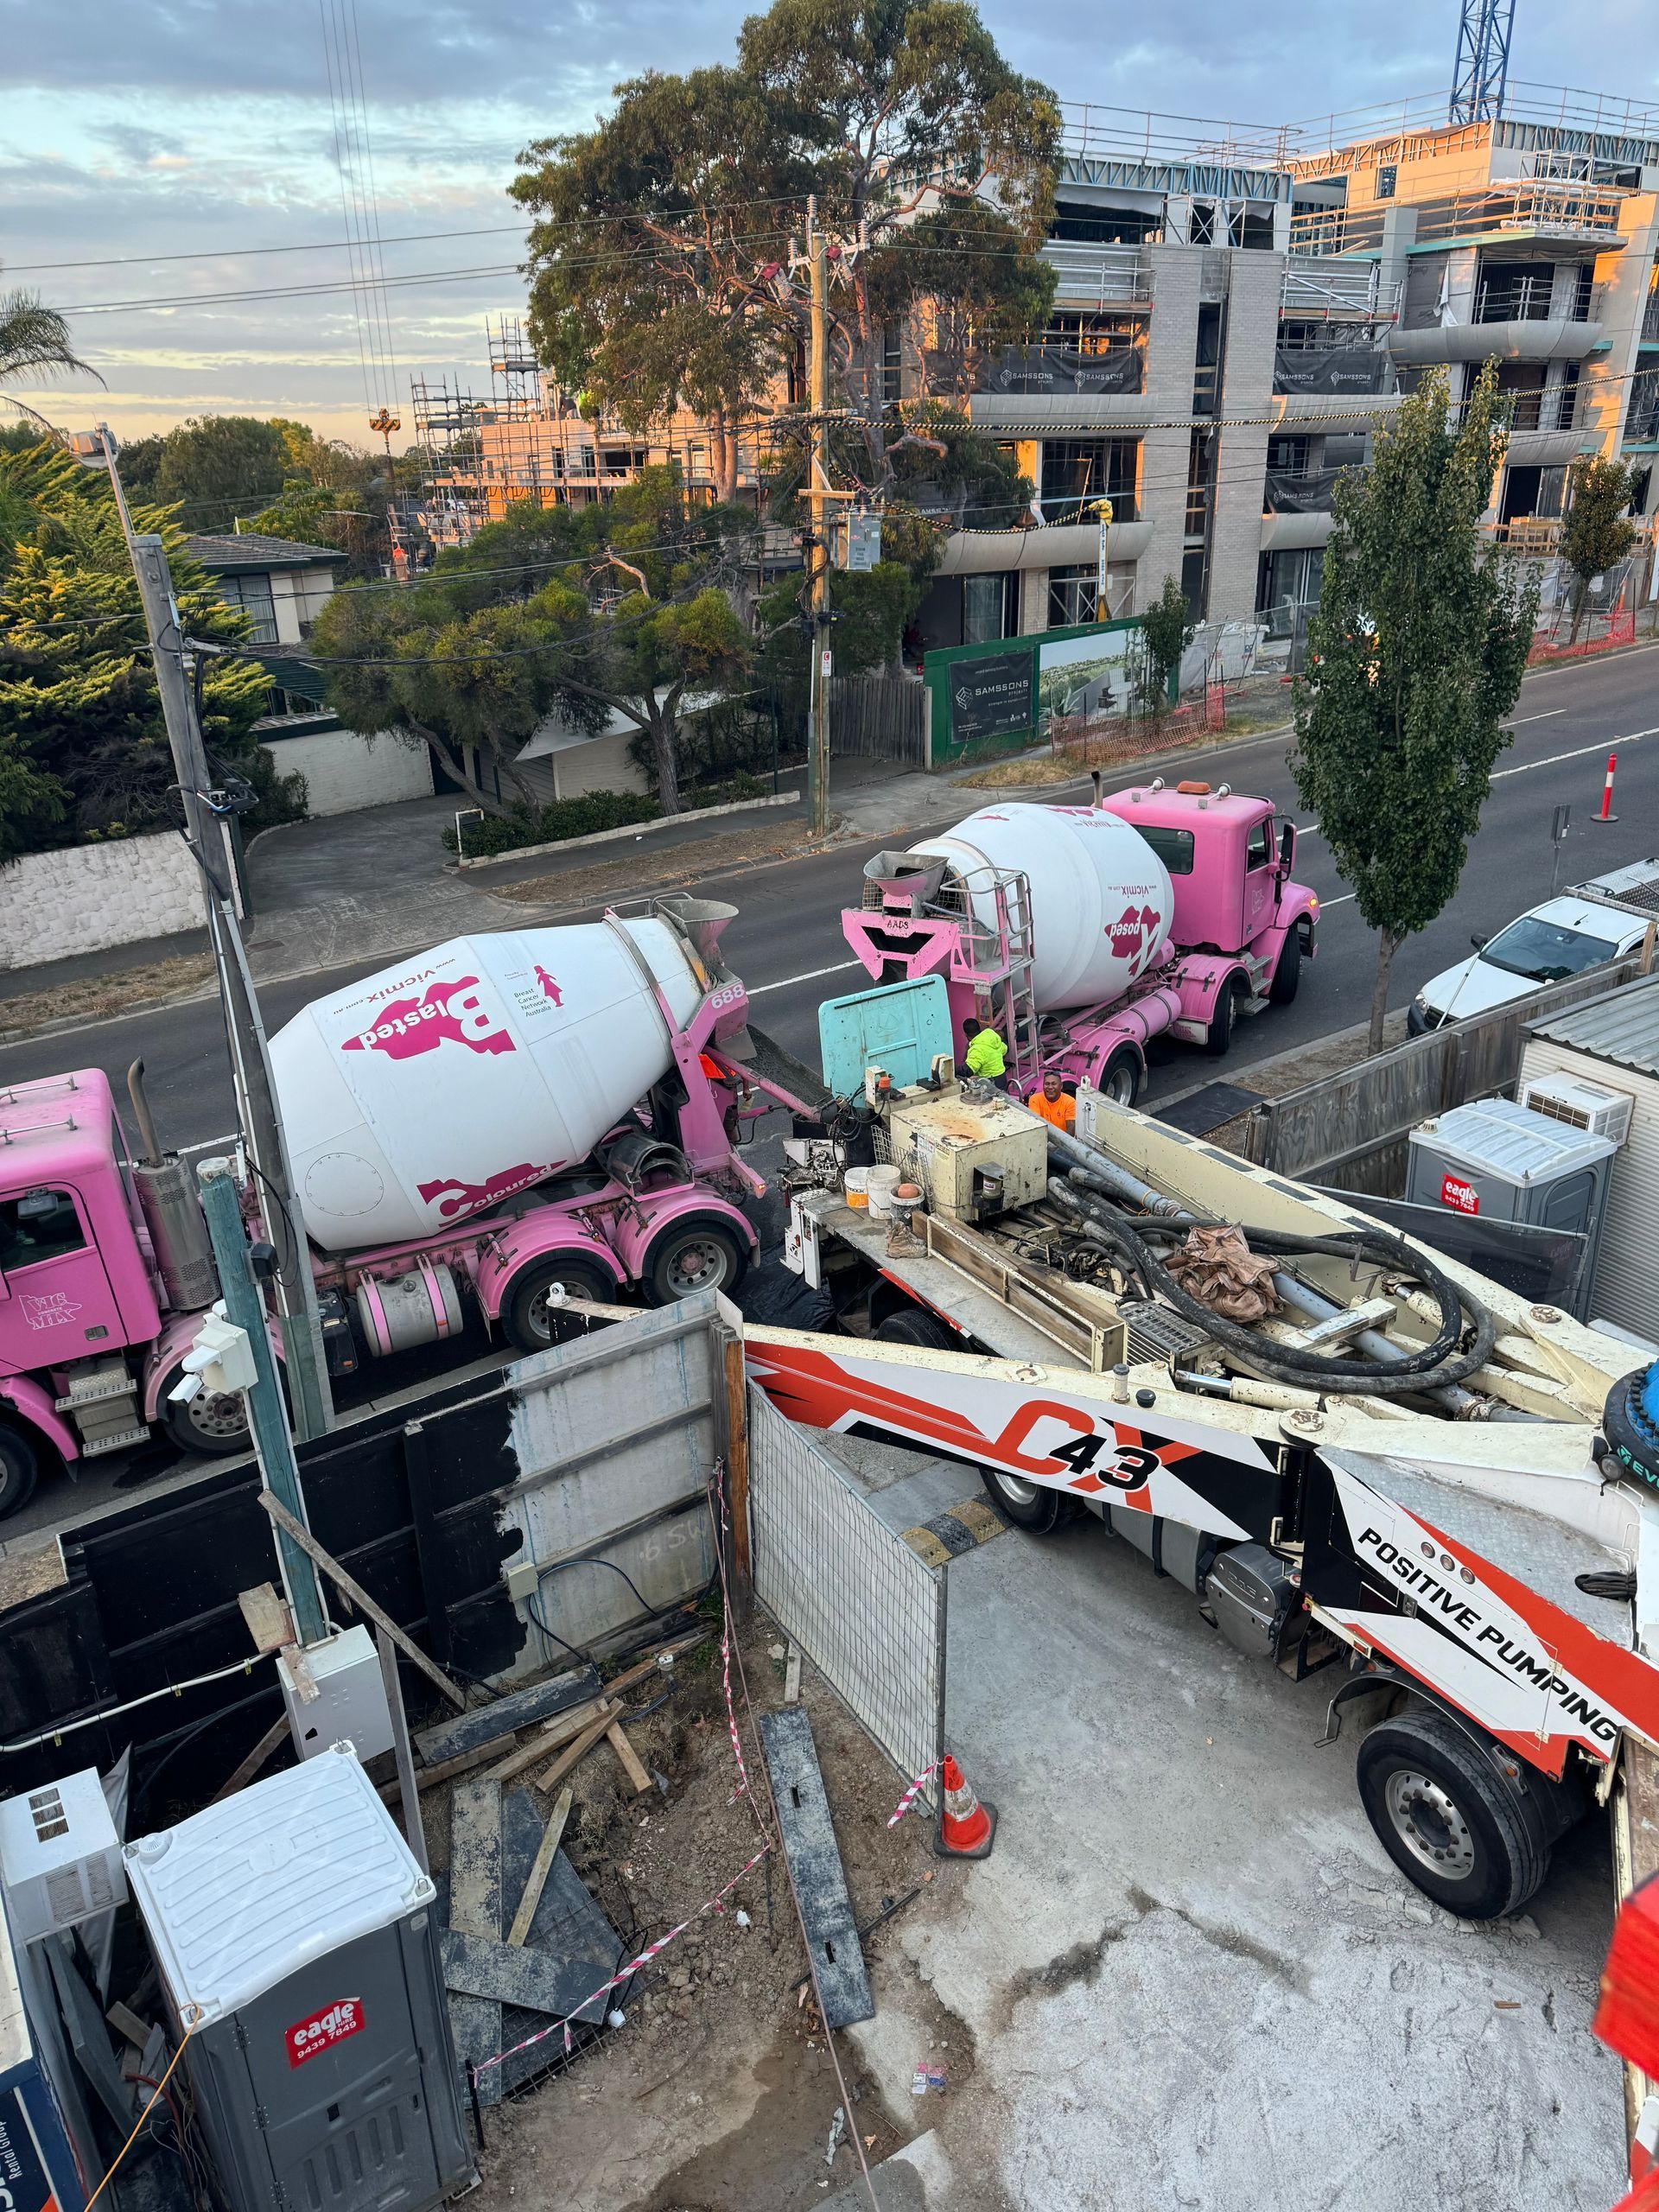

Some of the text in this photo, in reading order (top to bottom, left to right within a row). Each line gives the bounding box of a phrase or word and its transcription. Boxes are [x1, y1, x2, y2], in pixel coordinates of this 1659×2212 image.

[975, 680, 1029, 696] SAMSSONS
[513, 988, 534, 998] Breast
[518, 994, 539, 1004] Cancer
[520, 998, 548, 1011] Network
[711, 984, 745, 1009] 688
[359, 979, 507, 1051] Blasted
[525, 1005, 552, 1018] Australia
[429, 1165, 552, 1225] Coloured
[27, 1292, 67, 1312] VIC
[30, 1309, 77, 1331] MIX
[1357, 1527, 1482, 1631] POSITIVE
[1476, 1624, 1618, 1742] PUMPING
[294, 2003, 354, 2046] eagle
[297, 2020, 357, 2059] 9439 7849
[9, 2148, 22, 2180] Rental
